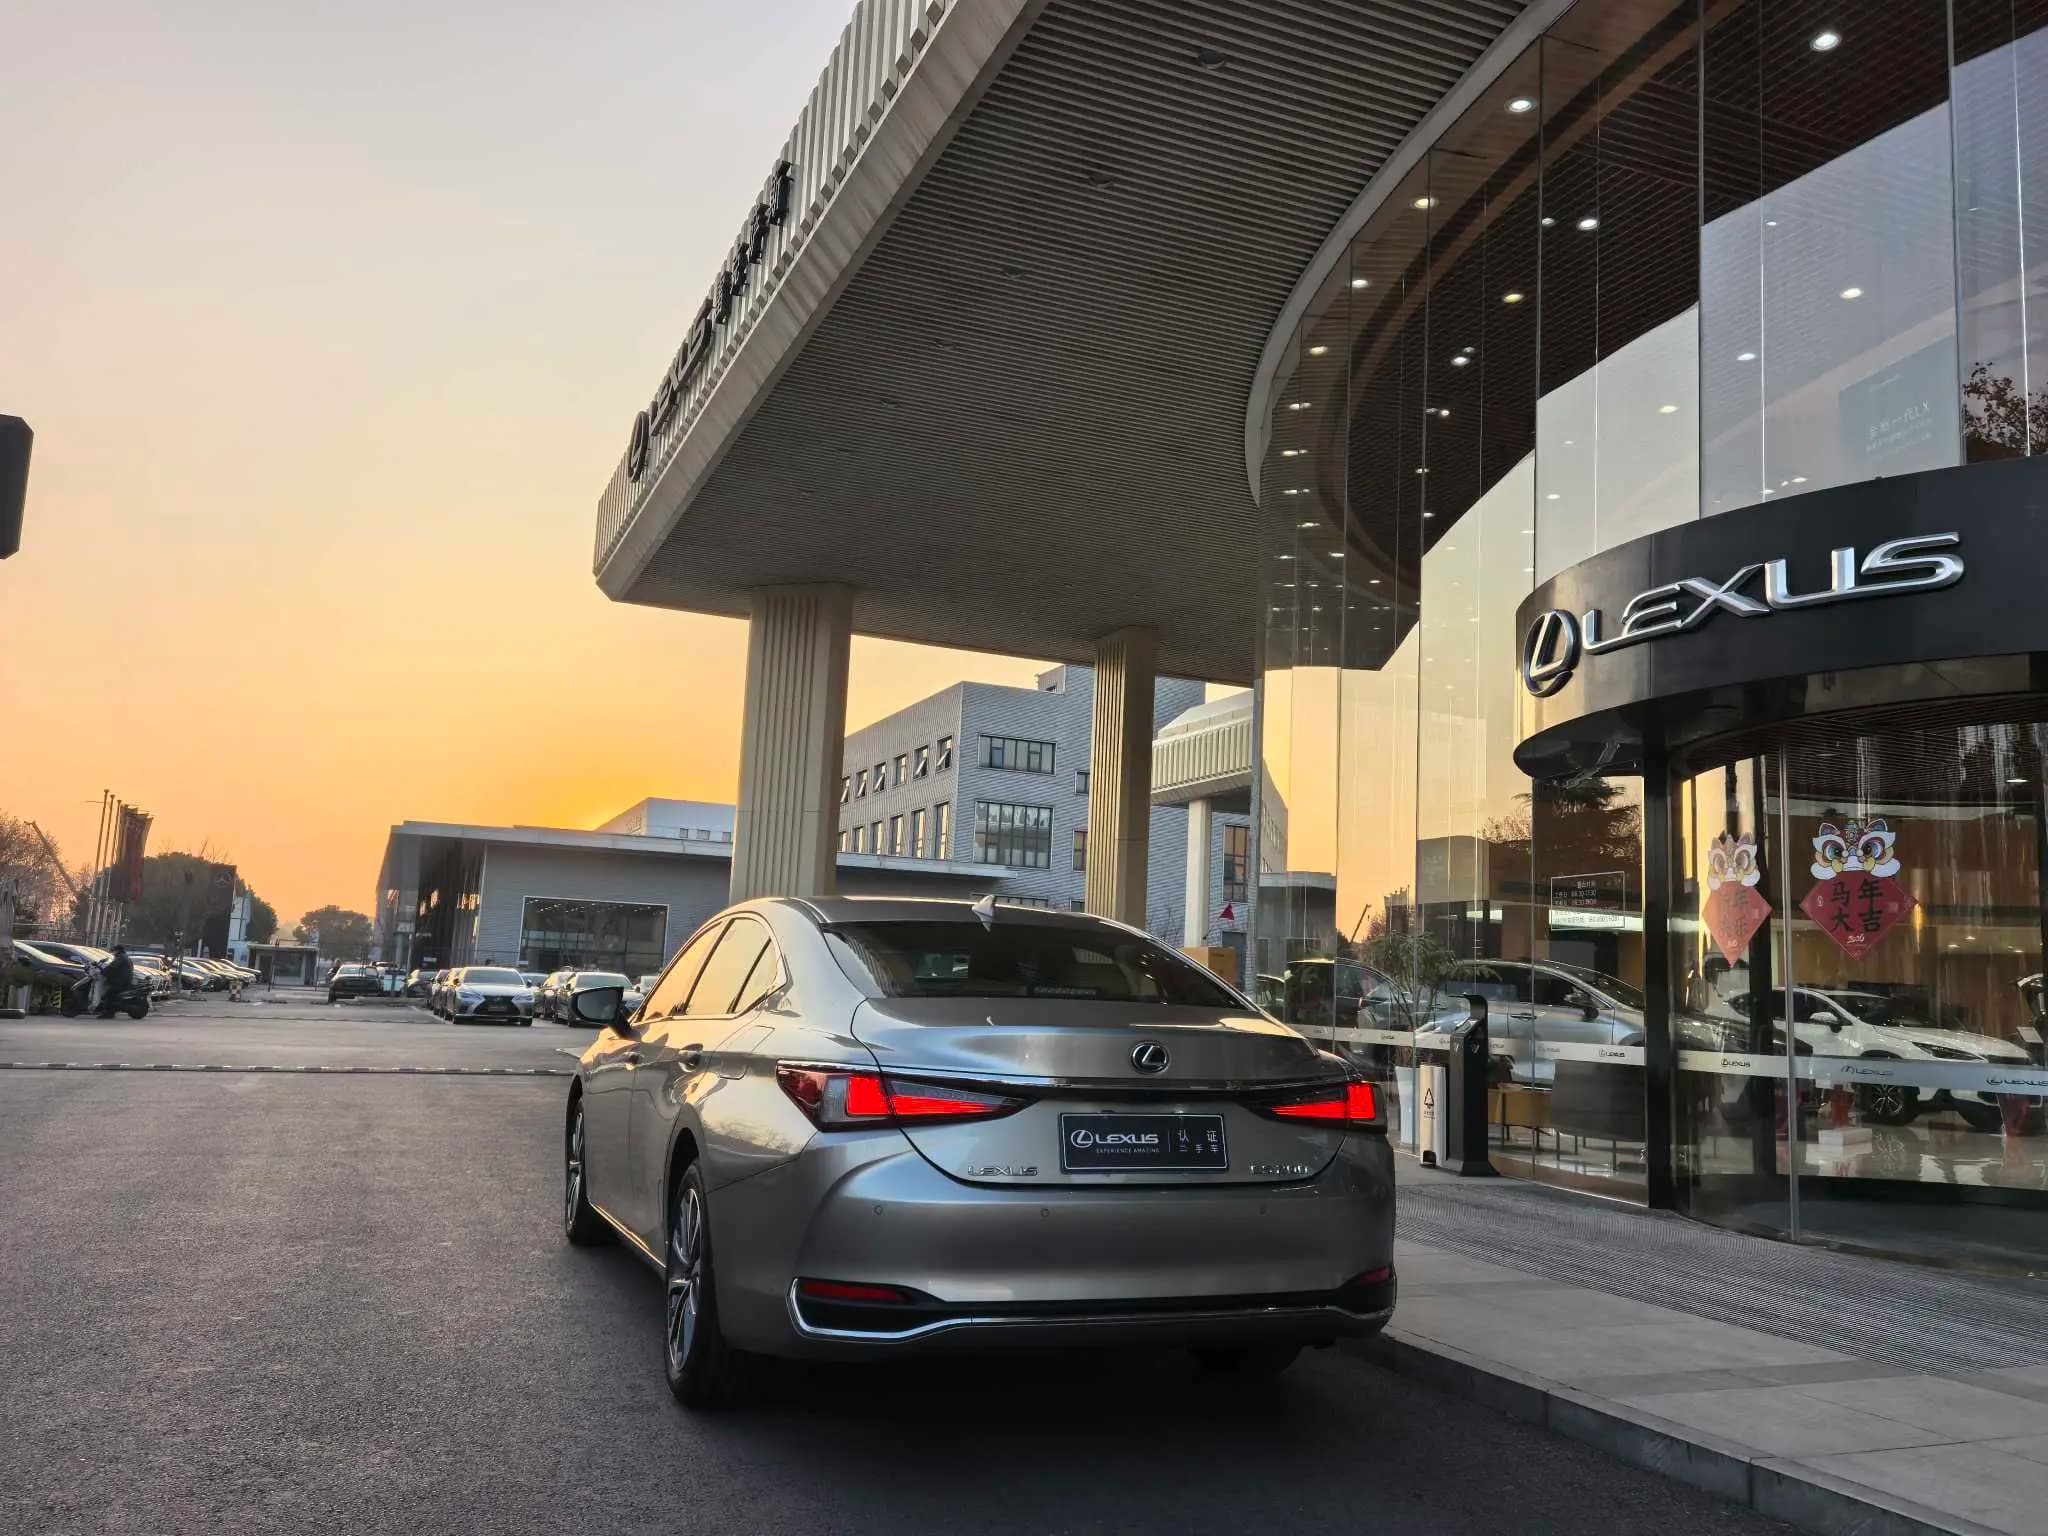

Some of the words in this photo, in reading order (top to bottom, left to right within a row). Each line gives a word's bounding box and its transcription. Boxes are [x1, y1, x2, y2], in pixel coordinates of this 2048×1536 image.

[1582, 531, 1965, 656] LEXUS
[1830, 907, 1884, 932] 大吉
[1096, 1133, 1160, 1144] LEXUS
[967, 1165, 1039, 1177] LEXUS
